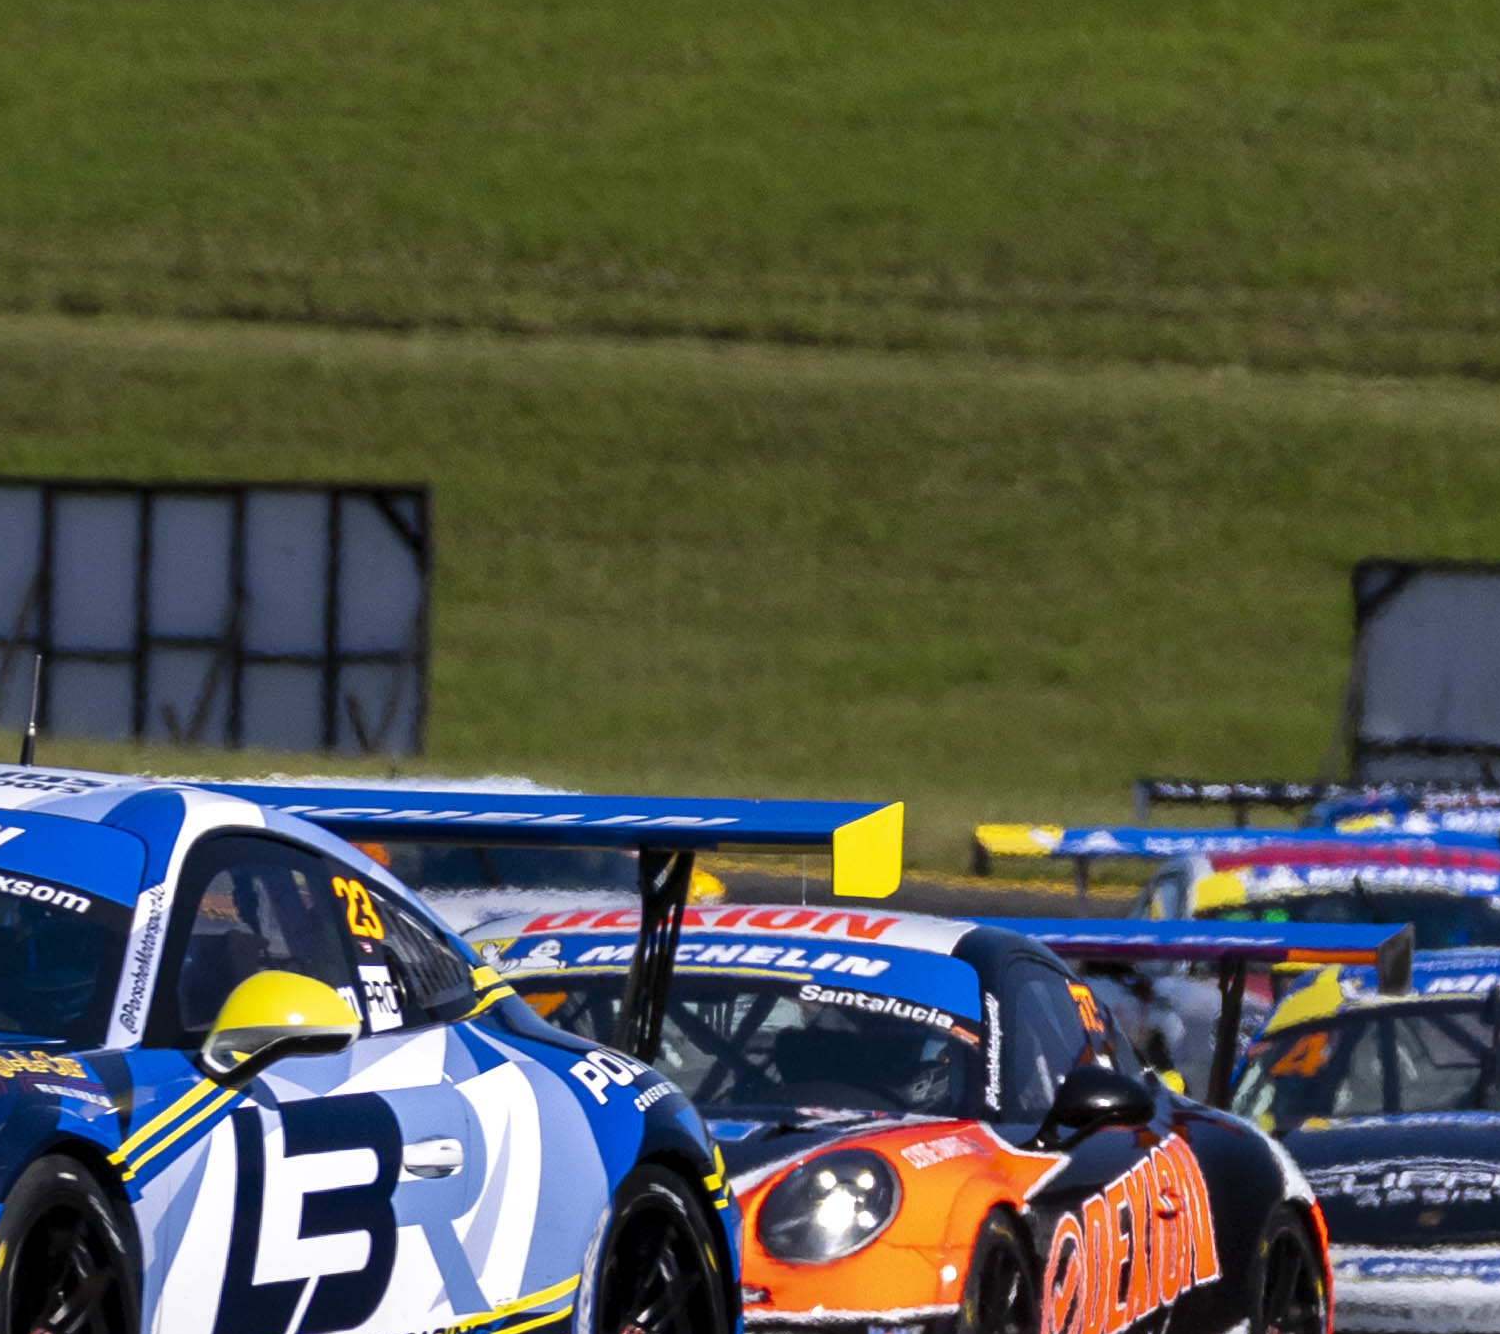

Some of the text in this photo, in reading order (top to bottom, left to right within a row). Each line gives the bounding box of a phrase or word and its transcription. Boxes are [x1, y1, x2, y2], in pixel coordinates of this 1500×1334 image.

[331, 876, 385, 940] 23
[576, 943, 891, 978] MCHELIN
[362, 979, 400, 1015] PRO
[799, 983, 956, 1030] Santalucia
[1270, 1031, 1330, 1077] 4
